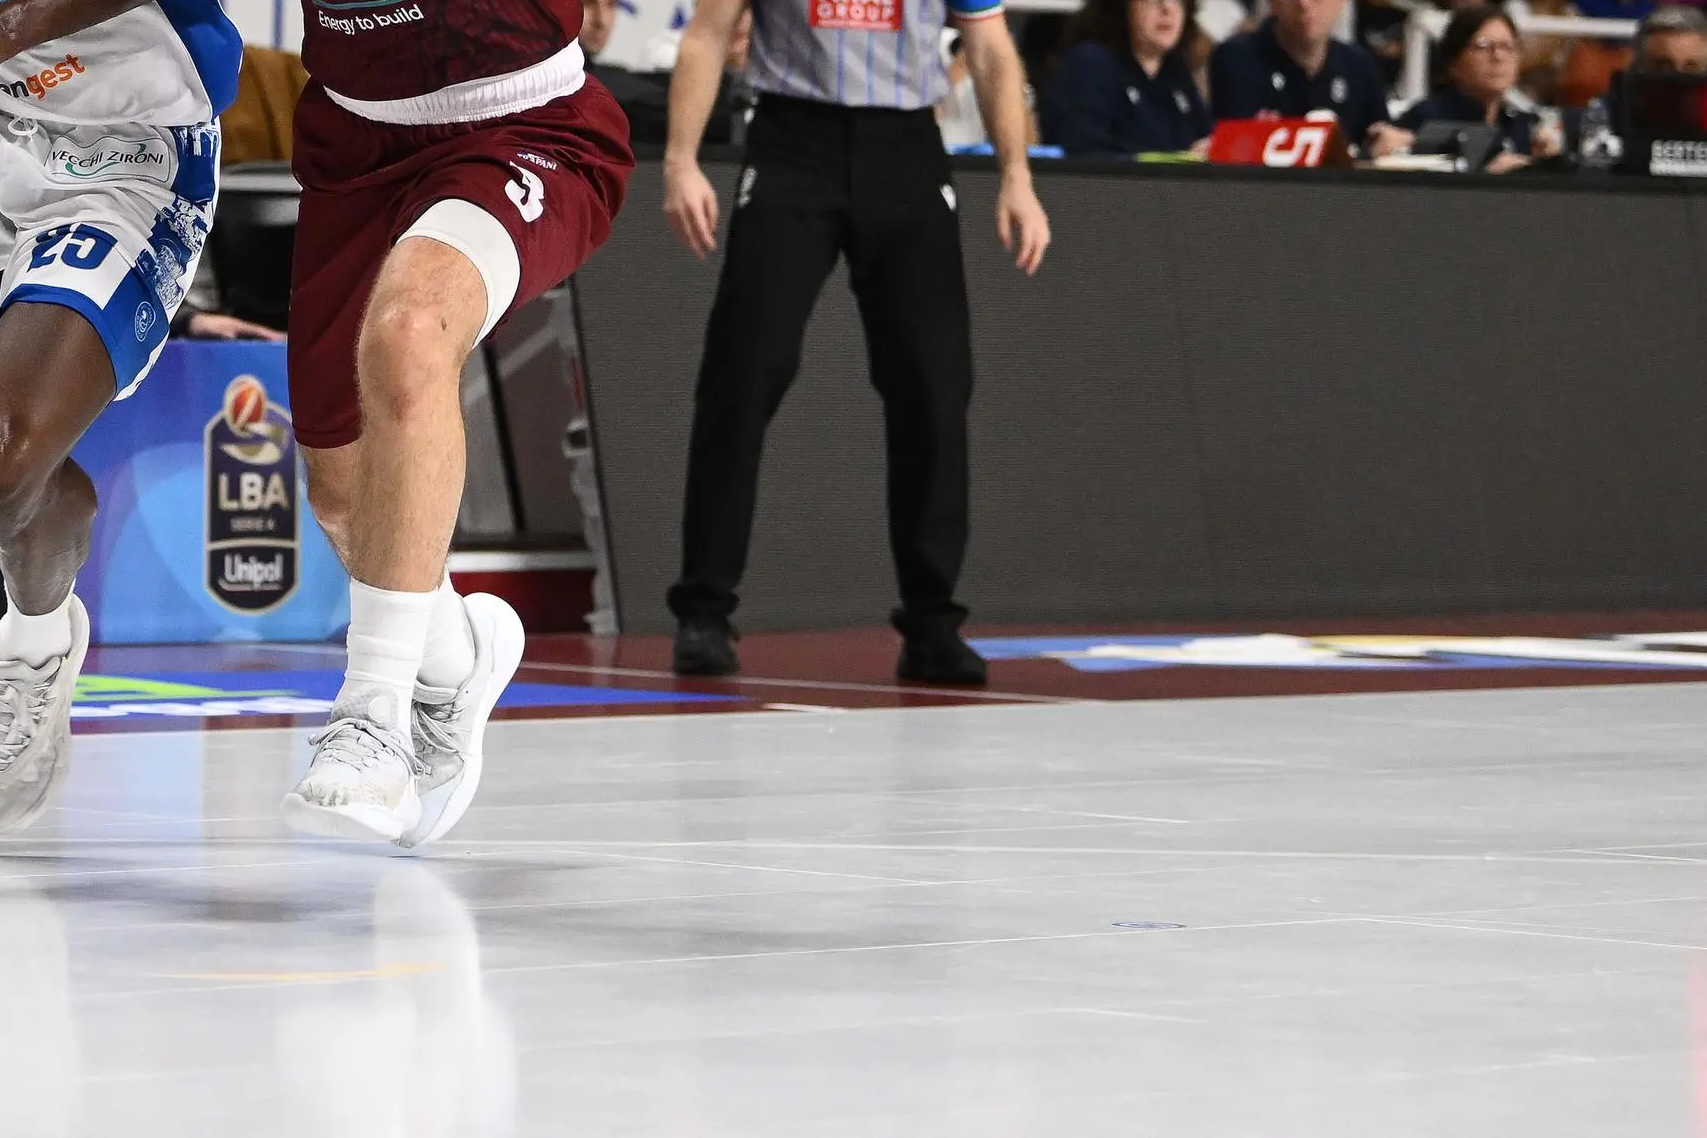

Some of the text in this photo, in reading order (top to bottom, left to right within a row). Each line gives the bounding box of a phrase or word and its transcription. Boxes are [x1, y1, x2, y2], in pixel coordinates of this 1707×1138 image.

[318, 3, 424, 35] Energy to build
[817, 4, 895, 22] GROUP
[52, 149, 164, 168] VECCHI ZIRONI
[27, 222, 118, 273] 25
[218, 472, 289, 511] LBA
[224, 552, 284, 592] Unipol
